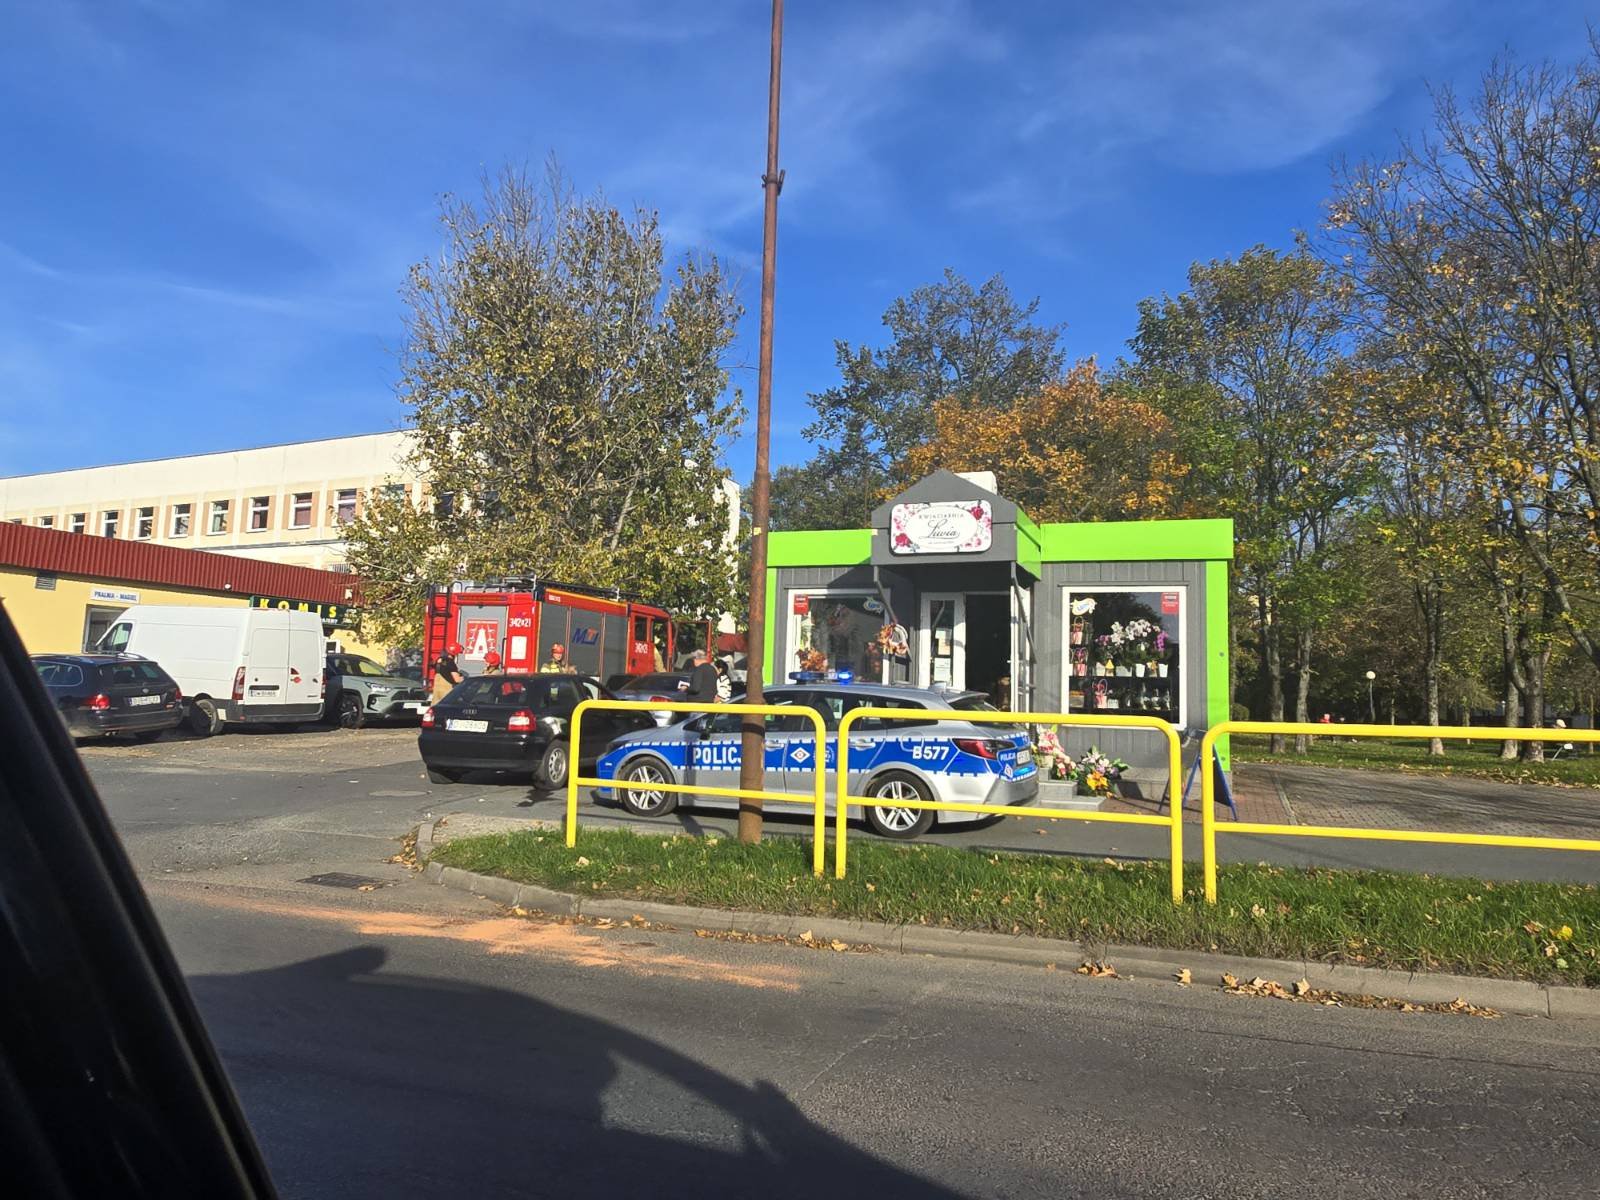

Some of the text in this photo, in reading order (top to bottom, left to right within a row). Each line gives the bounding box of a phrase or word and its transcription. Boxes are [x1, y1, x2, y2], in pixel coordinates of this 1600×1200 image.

[918, 518, 960, 539] Livia
[260, 598, 337, 618] KOMIS
[912, 746, 949, 761] B577
